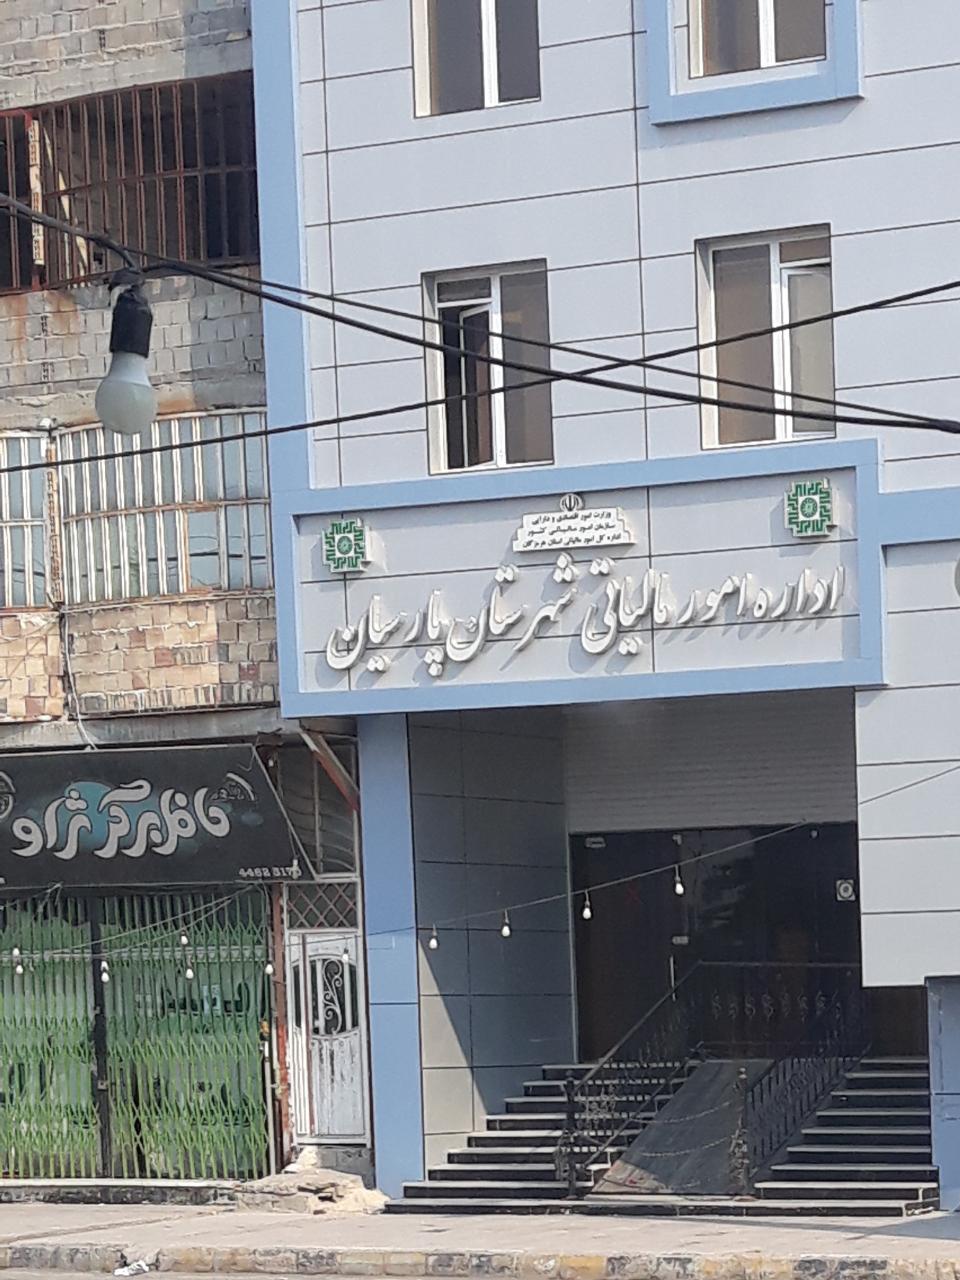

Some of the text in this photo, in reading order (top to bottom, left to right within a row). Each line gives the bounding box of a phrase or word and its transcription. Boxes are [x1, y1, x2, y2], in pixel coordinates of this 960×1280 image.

[326, 552, 845, 677] اداره امور مالیاتی شهرستان پارسیان
